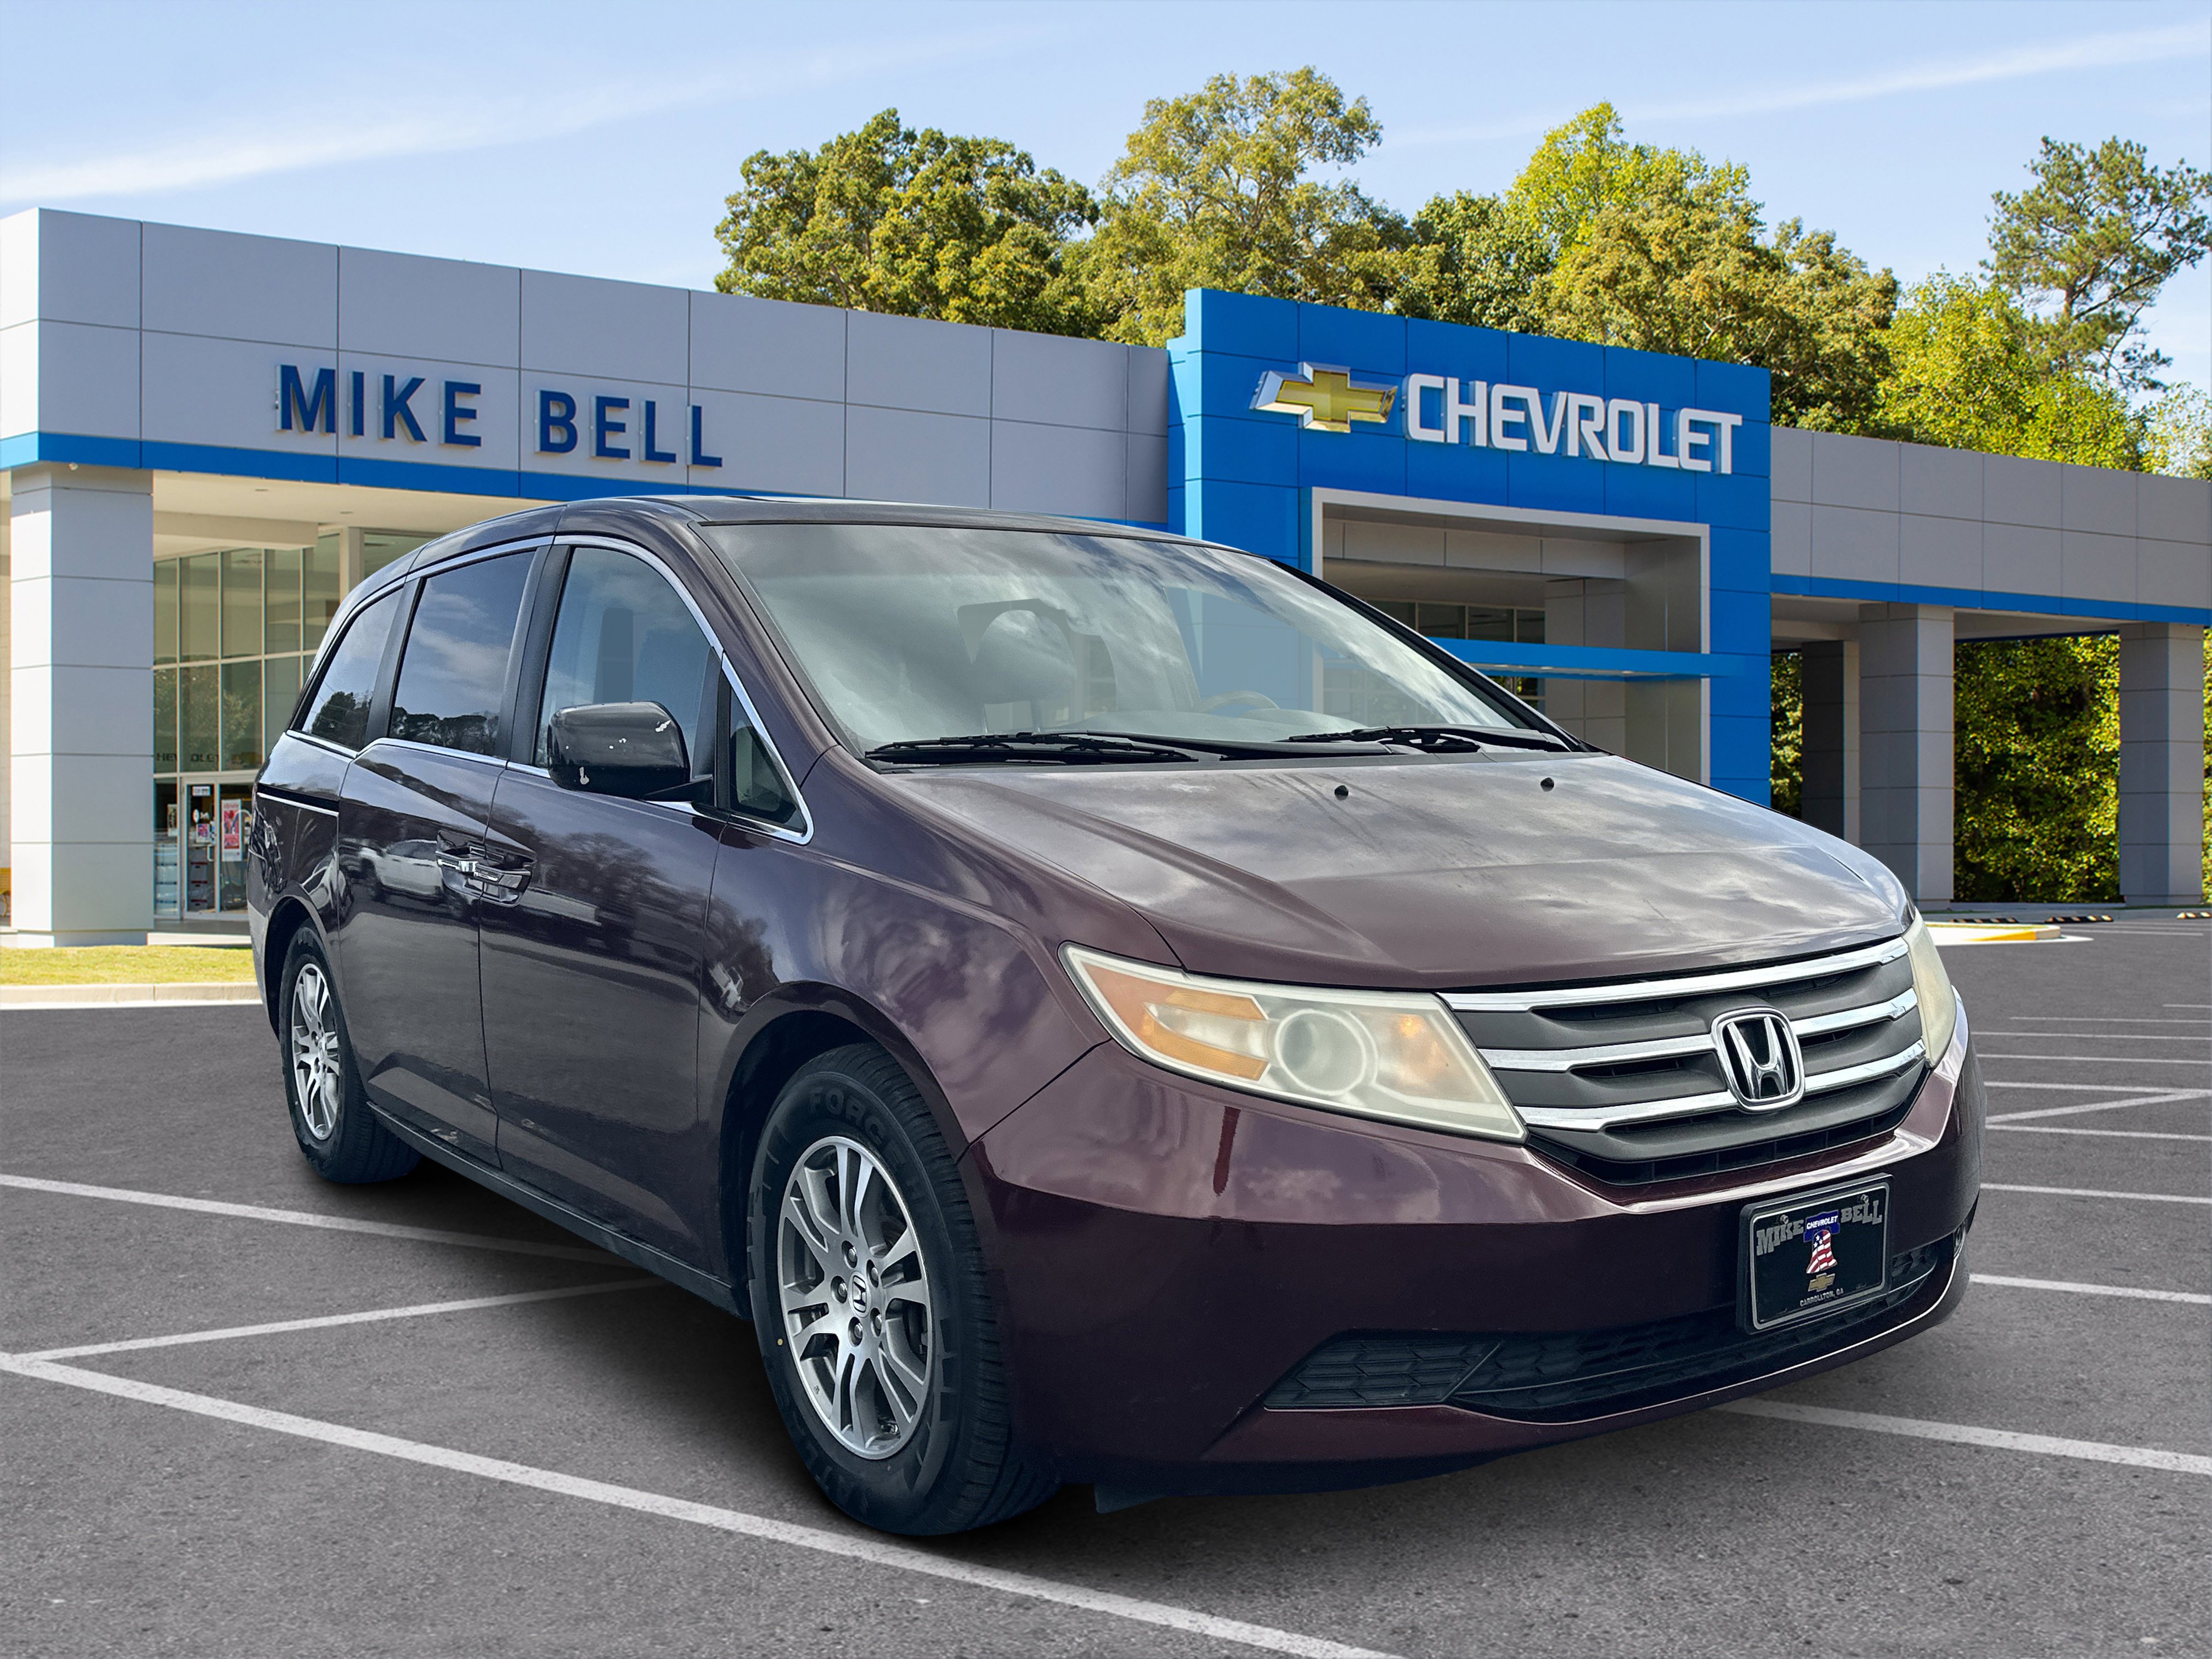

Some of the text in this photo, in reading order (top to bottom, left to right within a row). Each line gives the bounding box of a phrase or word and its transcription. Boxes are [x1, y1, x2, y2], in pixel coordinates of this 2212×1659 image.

[276, 364, 723, 468] MIKE BELL
[1401, 373, 1743, 475] CHEVROLET
[1757, 1200, 1882, 1256] MIKE CHEVROLET BELL
